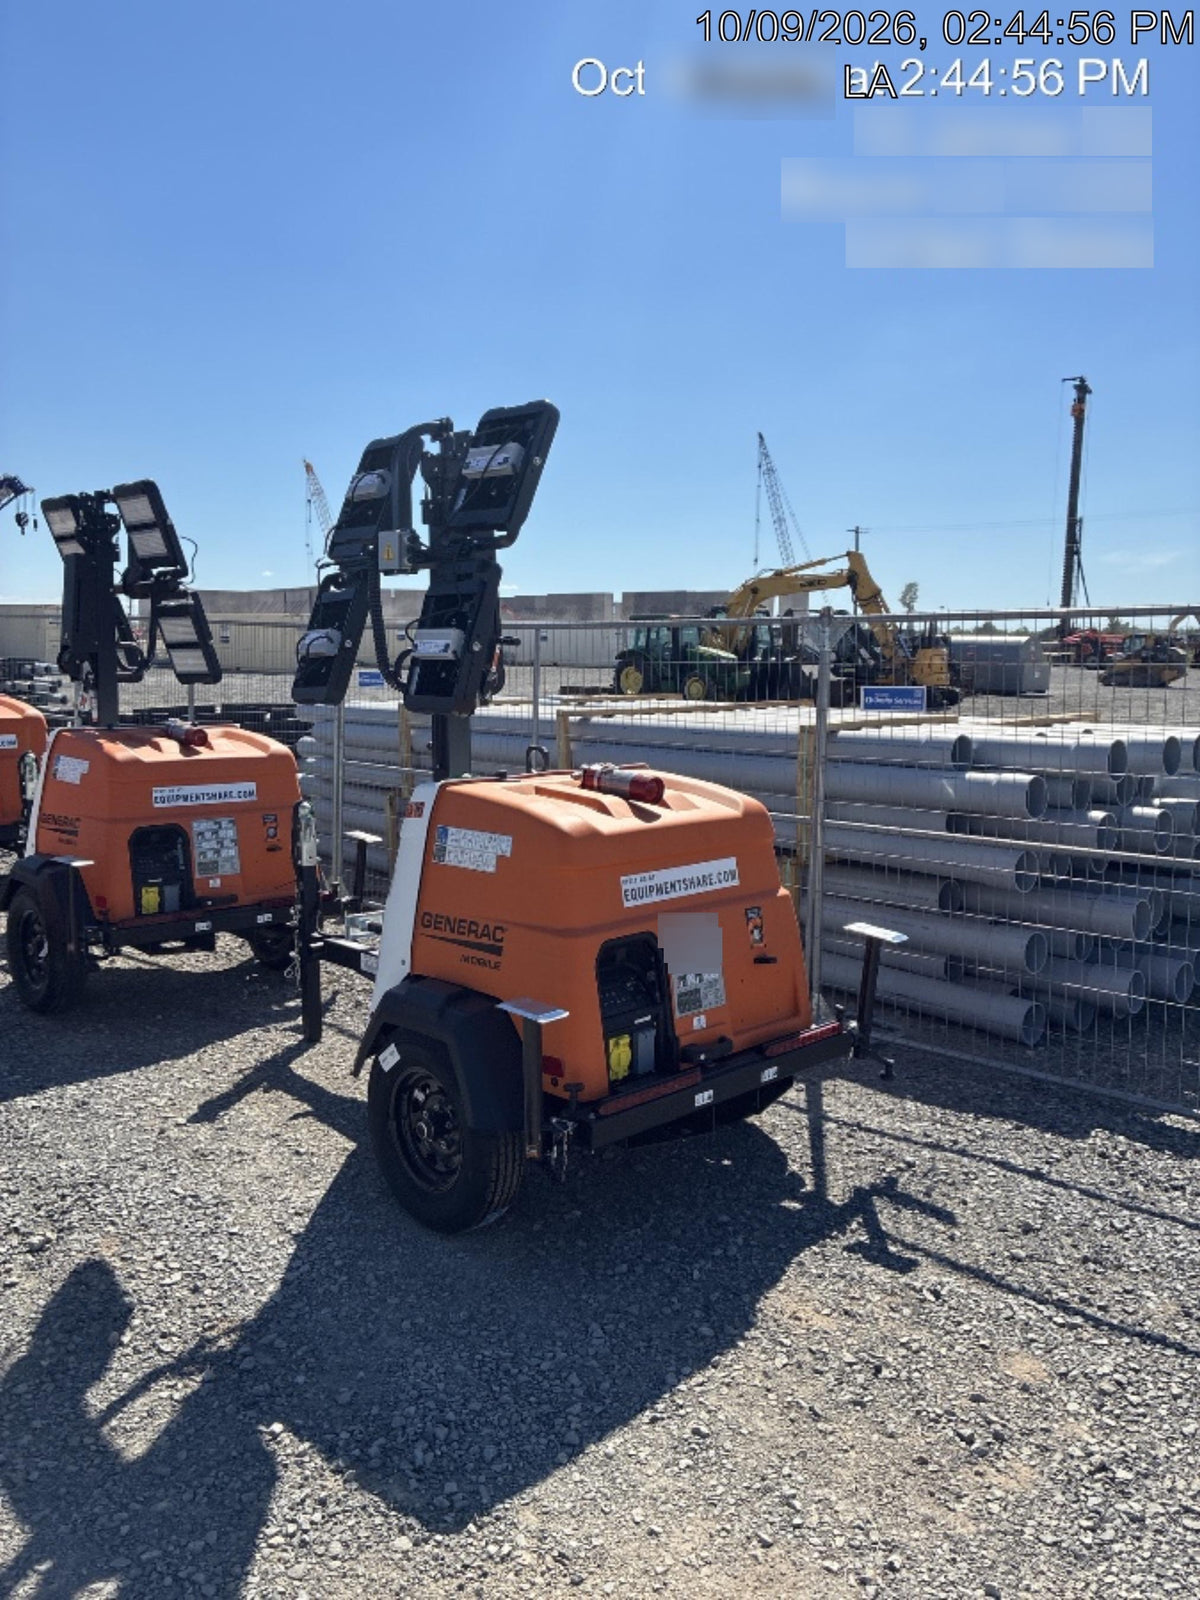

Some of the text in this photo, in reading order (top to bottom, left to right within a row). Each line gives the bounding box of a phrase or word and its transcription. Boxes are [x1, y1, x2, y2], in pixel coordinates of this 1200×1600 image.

[154, 789, 255, 804] EQUIPMENTSHARE.COM
[623, 868, 738, 903] EQUIPMENTSHARE.COM
[421, 911, 506, 943] GENERAC
